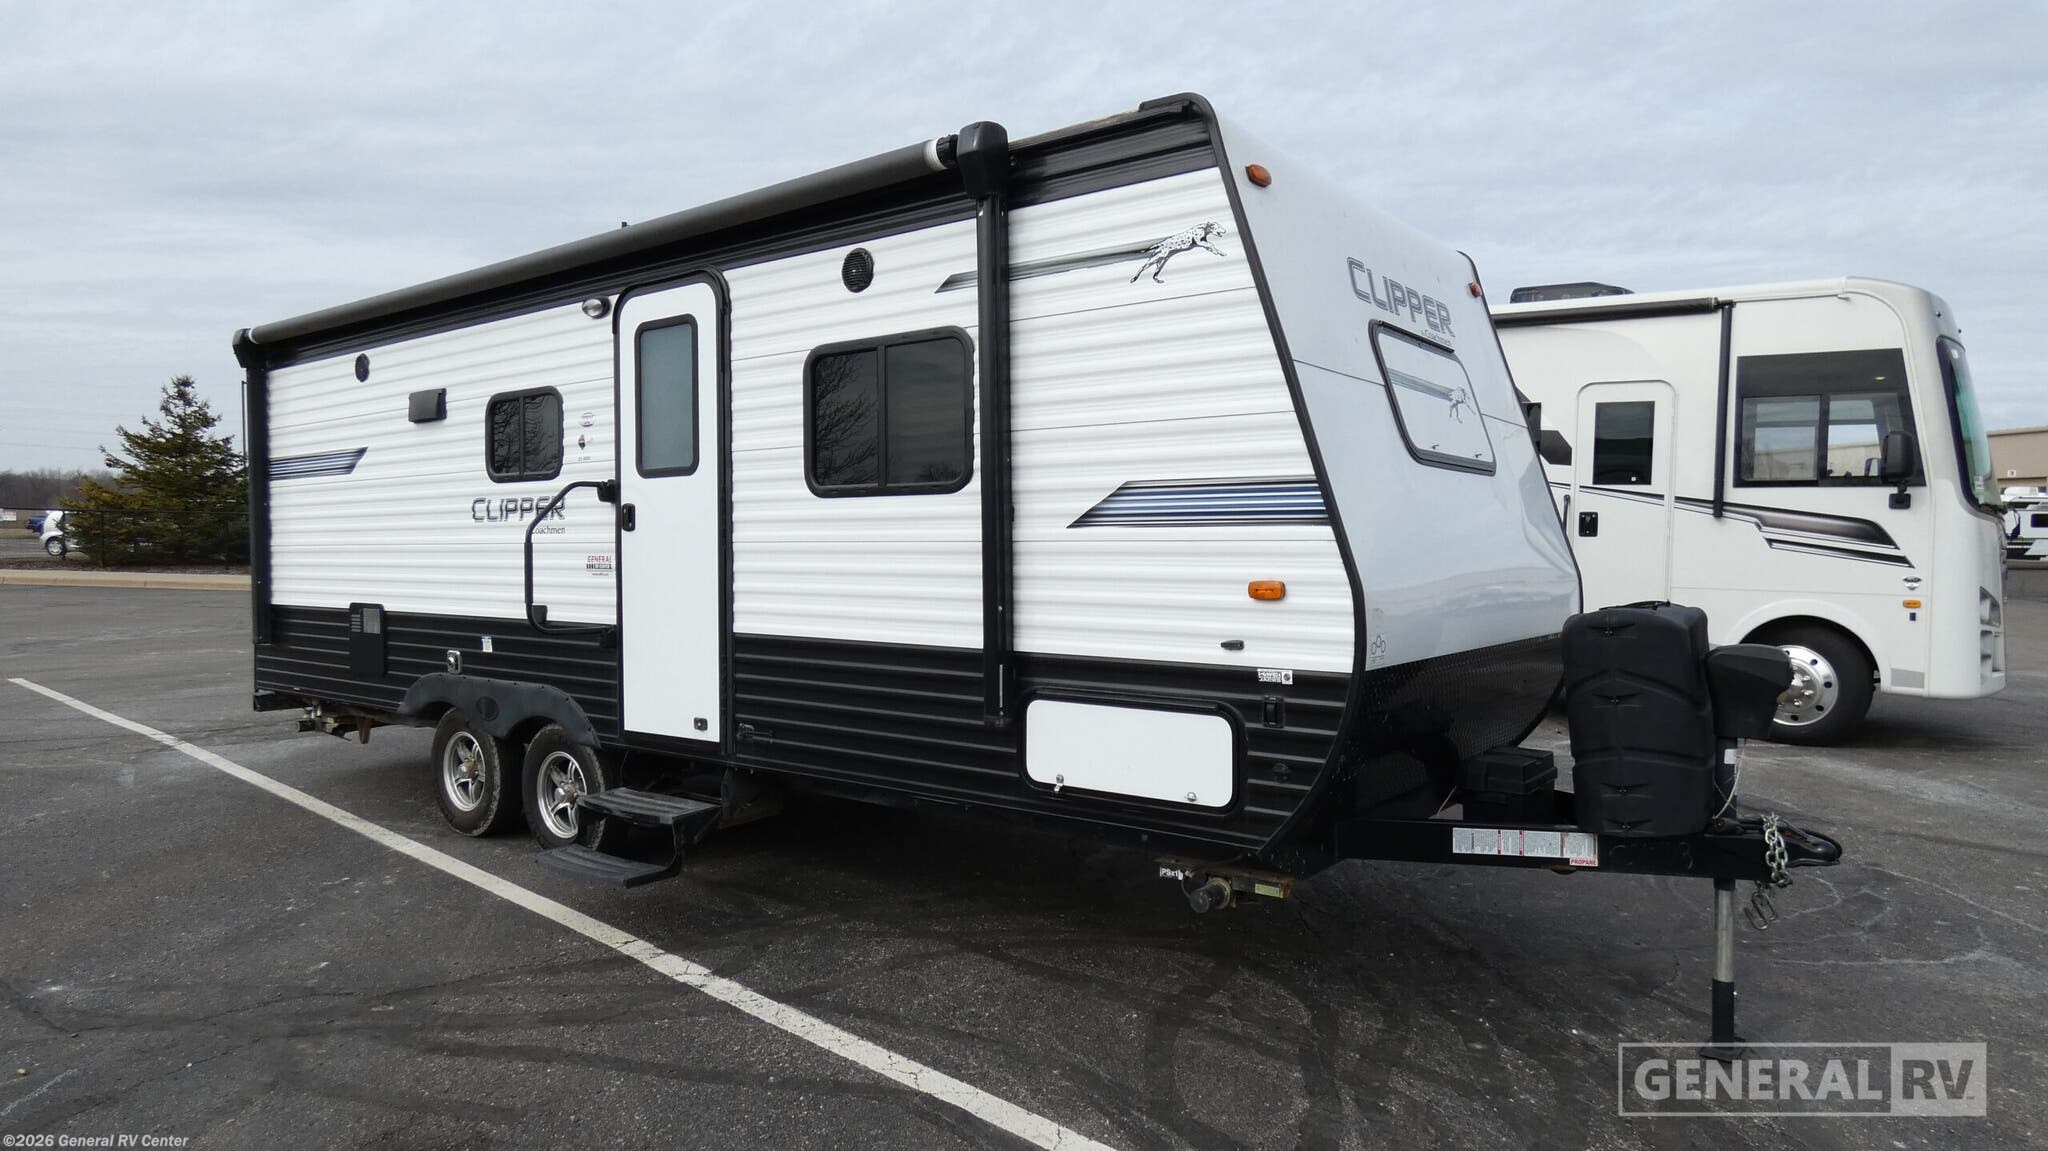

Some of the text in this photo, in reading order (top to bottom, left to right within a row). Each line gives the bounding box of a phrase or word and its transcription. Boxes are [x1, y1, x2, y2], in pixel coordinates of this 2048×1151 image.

[1346, 256, 1455, 338] CLIPPER
[472, 496, 566, 522] CLIPPER
[1570, 858, 1597, 866] PROPANE
